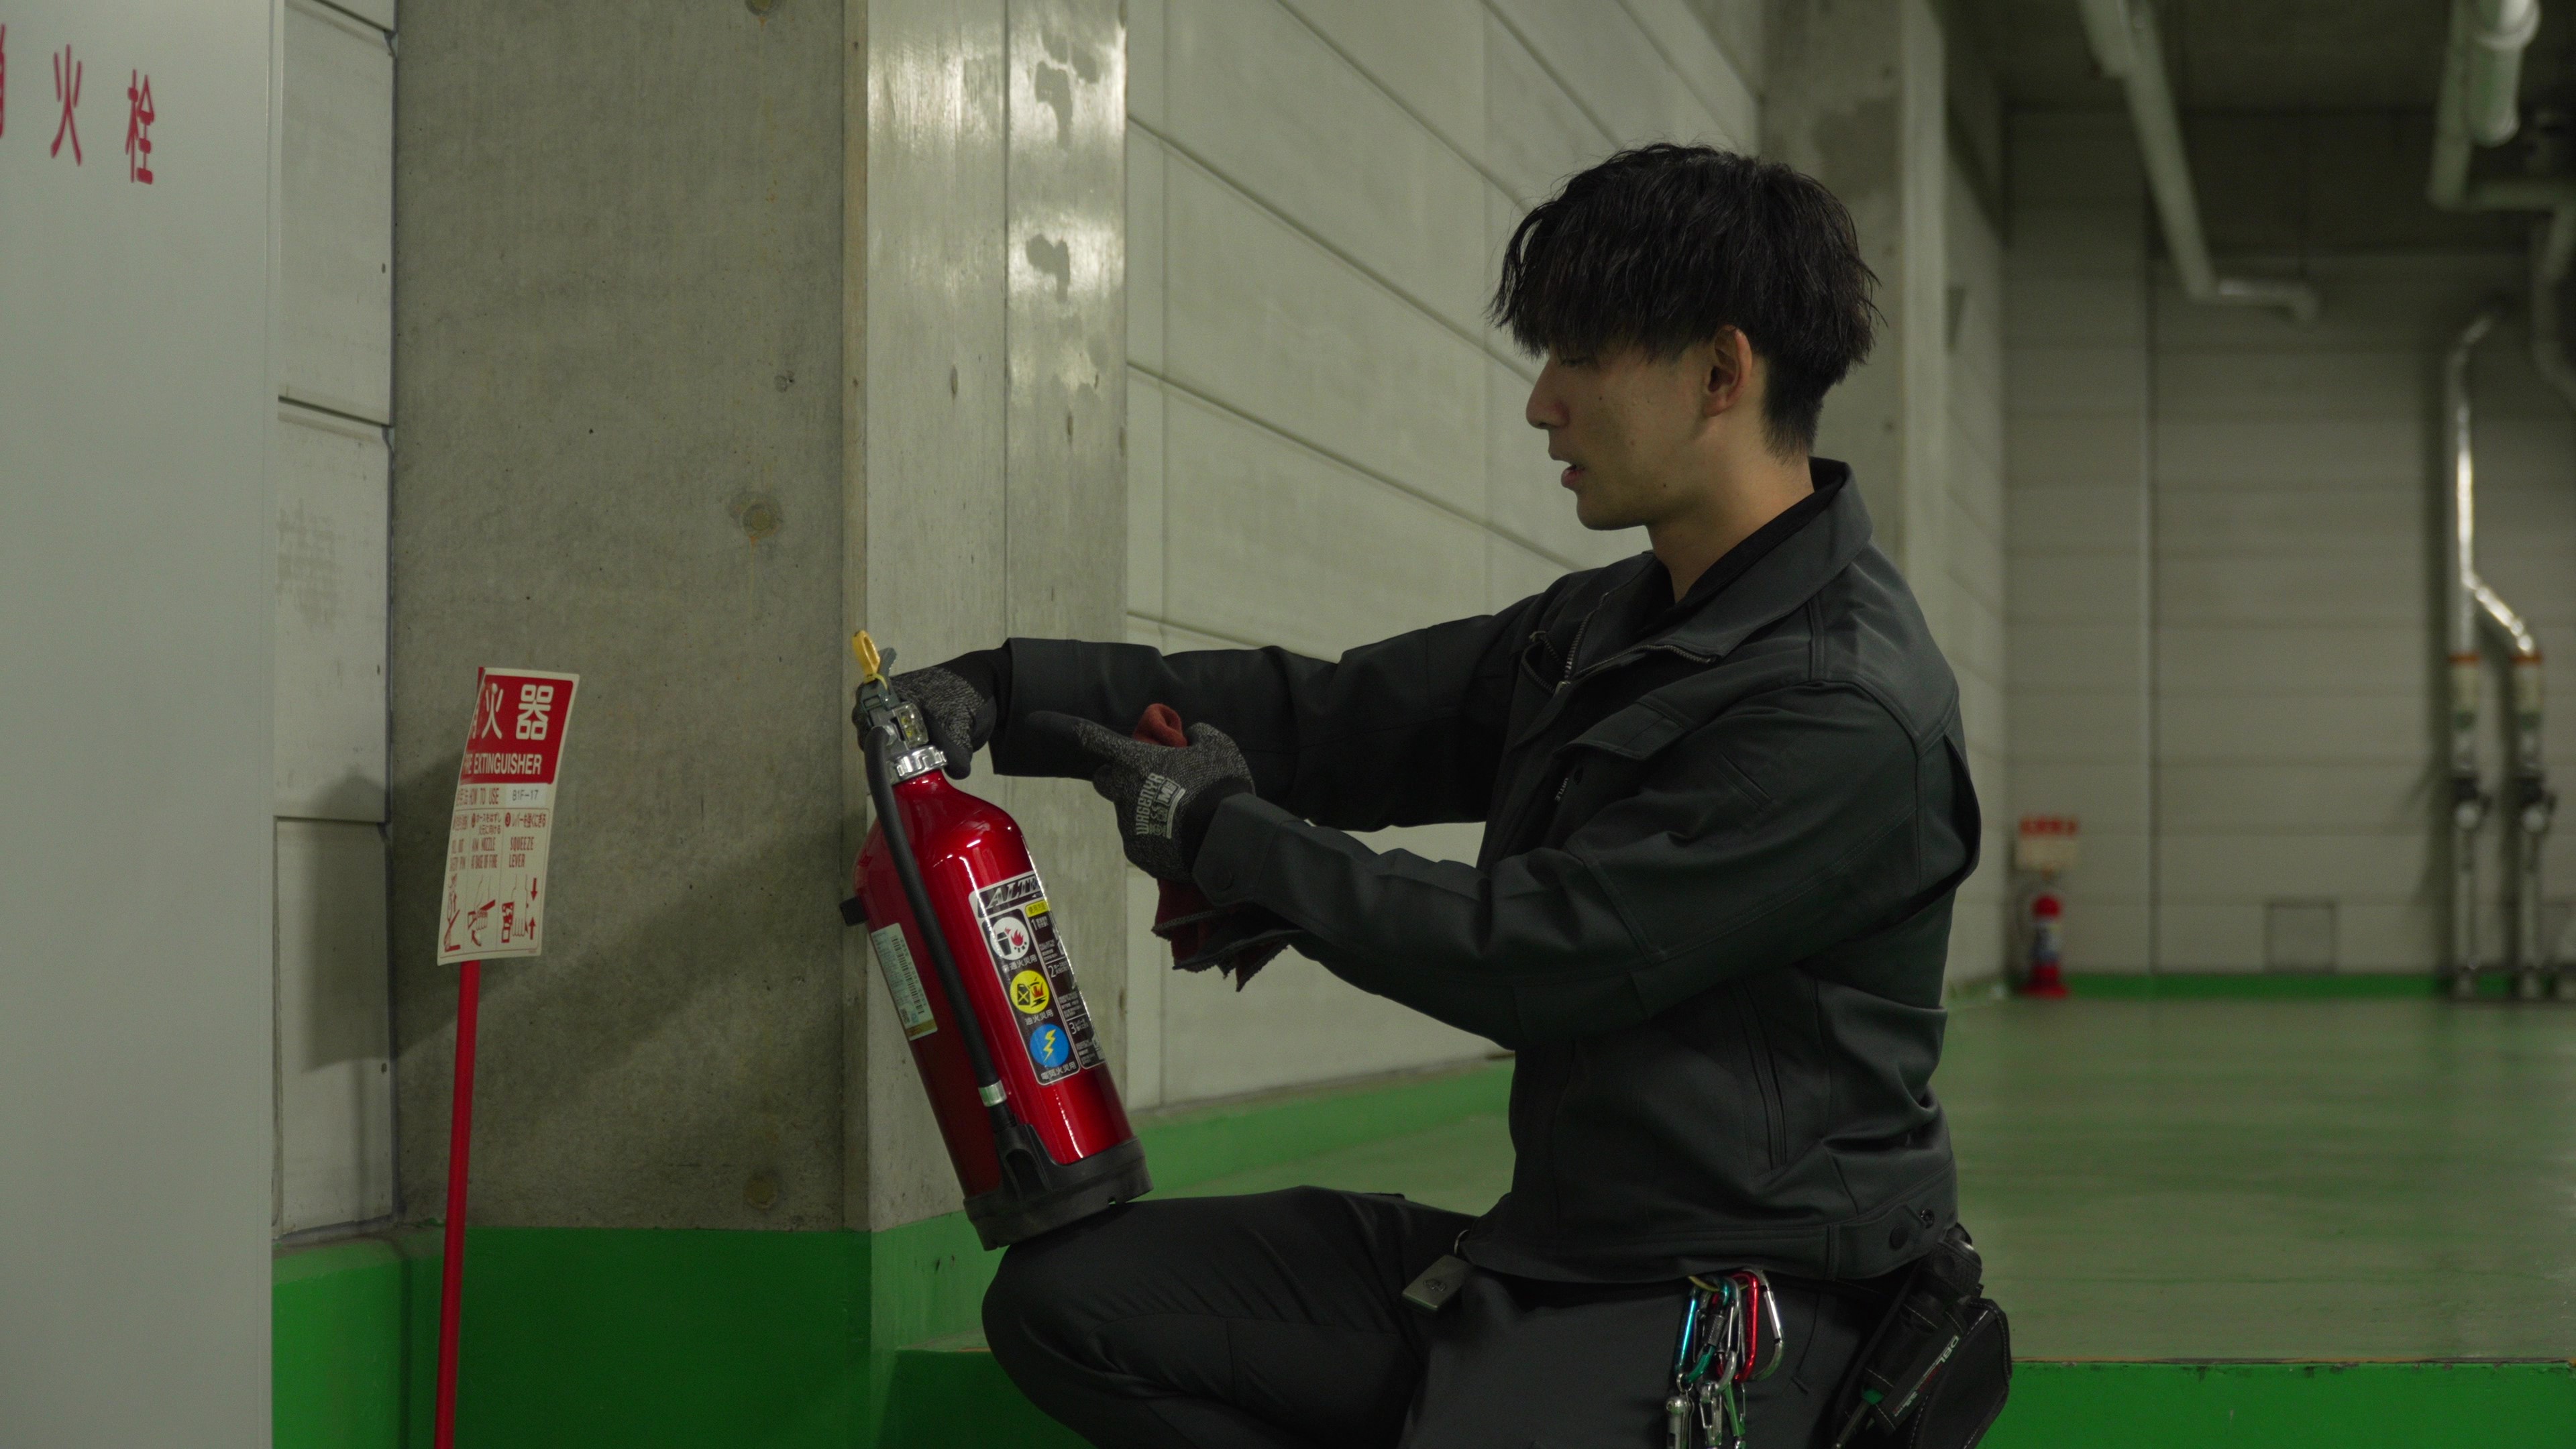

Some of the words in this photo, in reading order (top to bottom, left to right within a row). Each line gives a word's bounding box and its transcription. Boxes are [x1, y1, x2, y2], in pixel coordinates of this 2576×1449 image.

[0, 24, 155, 185] 火栓
[470, 682, 554, 741] 火器
[474, 752, 543, 775] EXTINGUISHER
[512, 789, 539, 801] B1F-17
[510, 837, 535, 852] SQUEEZE
[508, 853, 525, 868] LEVER
[1025, 1008, 1054, 1026] 油火災用
